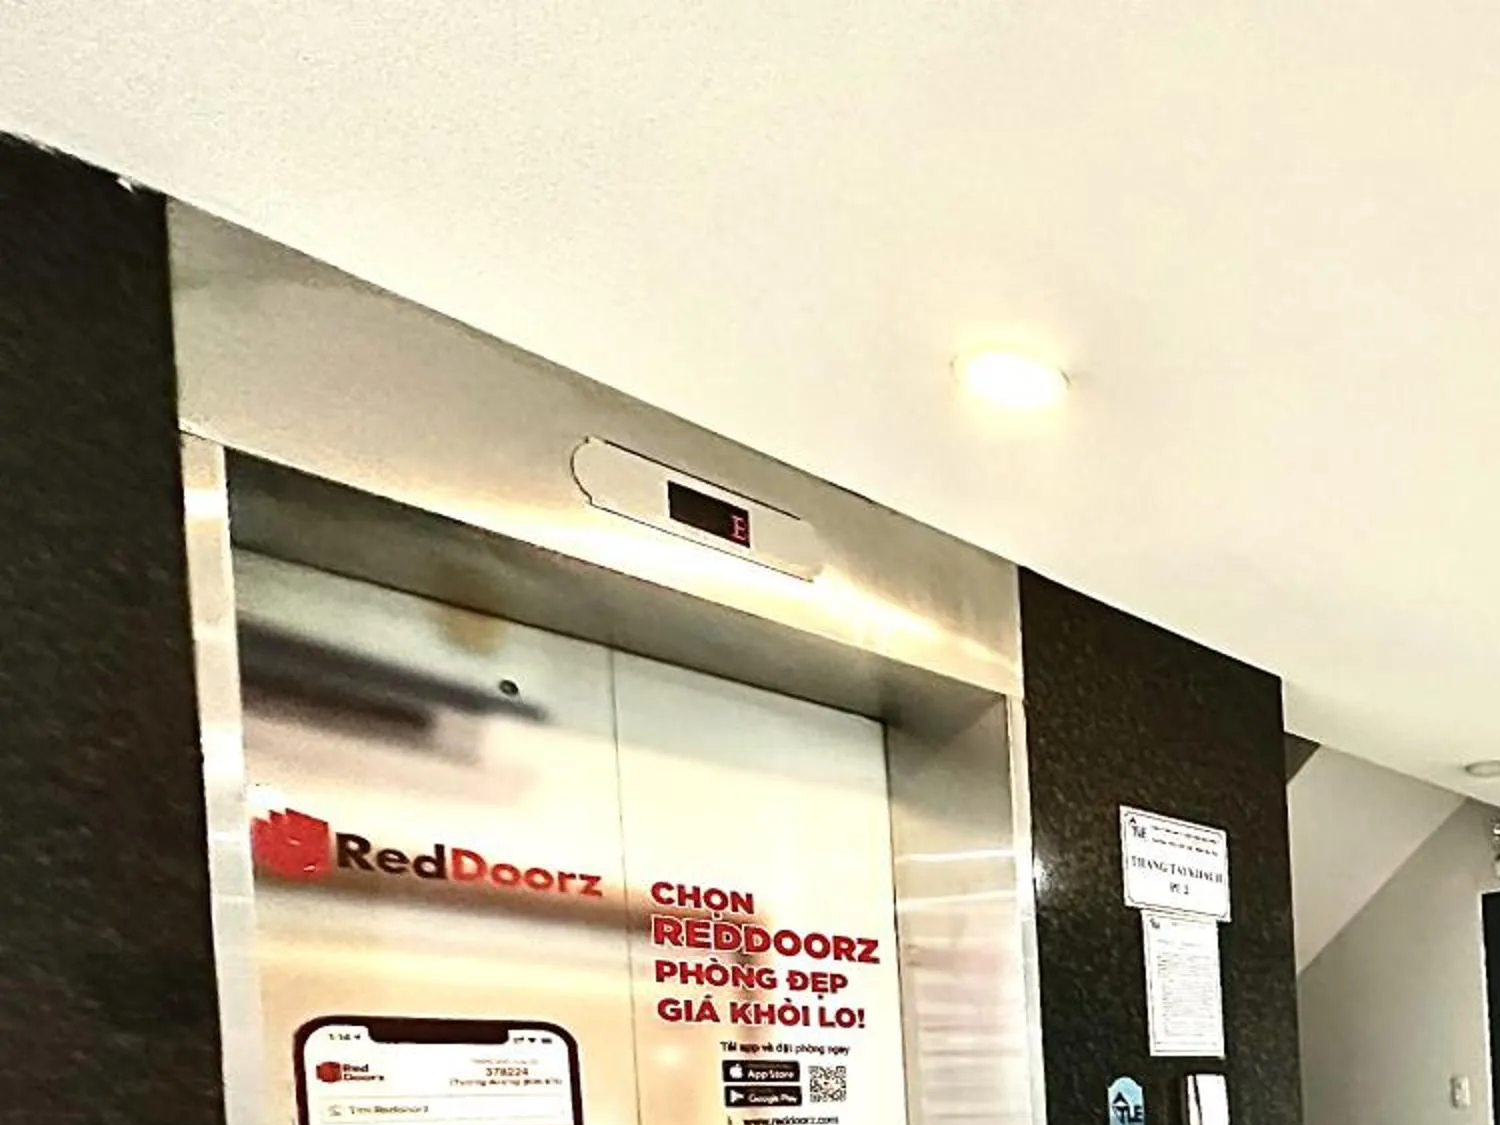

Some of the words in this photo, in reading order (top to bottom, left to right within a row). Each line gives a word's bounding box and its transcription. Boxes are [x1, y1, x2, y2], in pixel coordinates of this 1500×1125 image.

[335, 831, 603, 898] RedDoorz
[650, 881, 755, 919] CHỌN
[653, 916, 881, 964] REDDOORZ
[655, 957, 777, 990] PHÒNG
[786, 969, 849, 1000] ĐẸP
[818, 1006, 866, 1029] LO!
[828, 1045, 851, 1056] ngay
[343, 1063, 369, 1073] Red
[747, 1069, 768, 1080] App
[769, 1069, 795, 1080] Store
